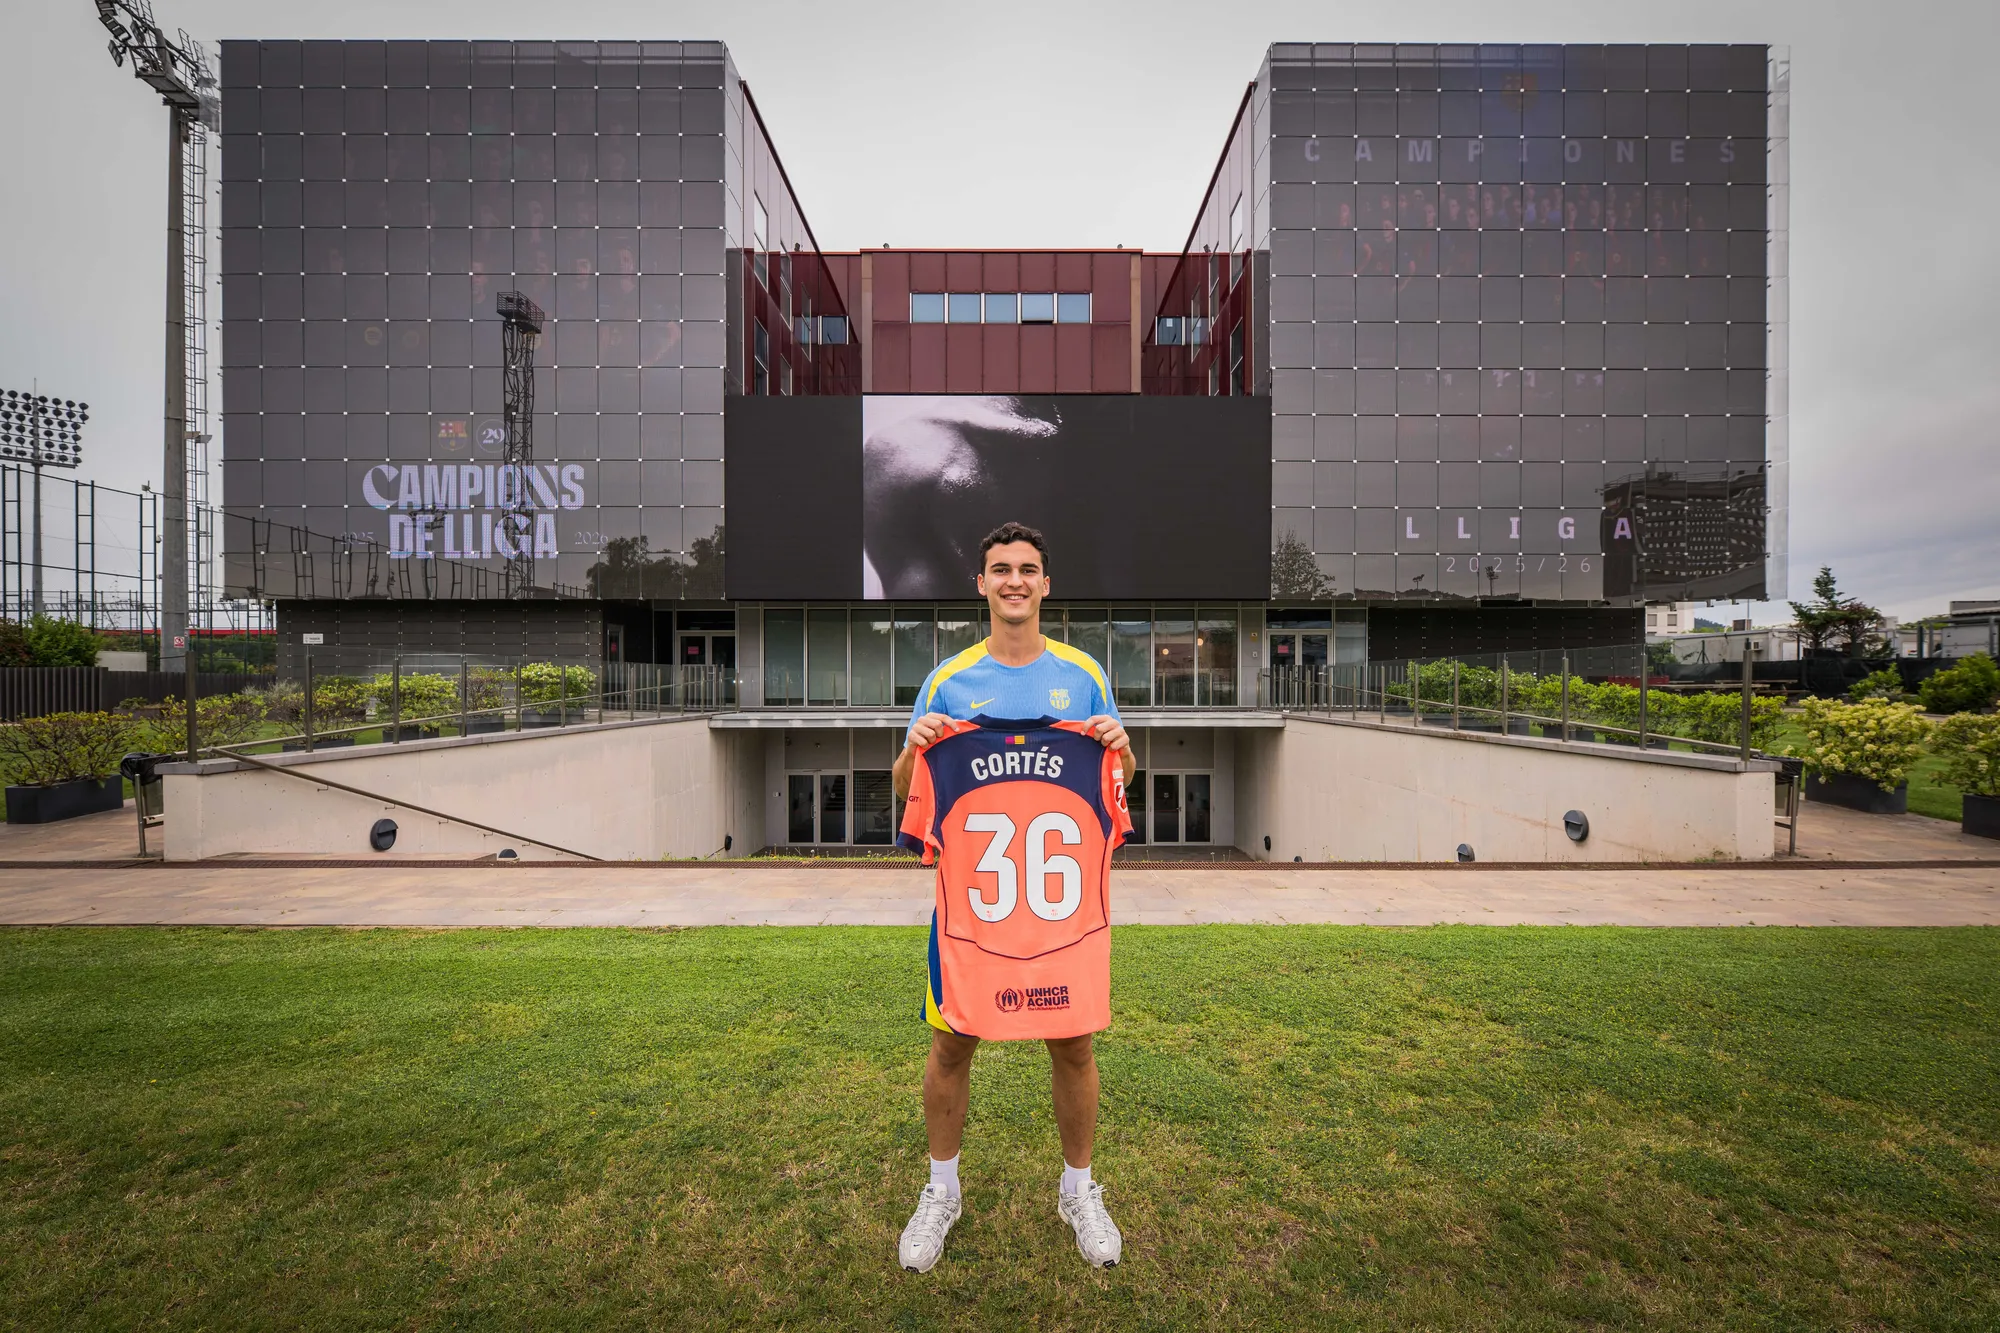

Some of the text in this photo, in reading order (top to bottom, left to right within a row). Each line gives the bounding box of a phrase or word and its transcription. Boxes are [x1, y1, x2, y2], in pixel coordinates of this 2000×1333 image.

[1304, 139, 1736, 163] CAMPIONES
[362, 464, 585, 510] CAMPIONS
[574, 531, 609, 545] 2026
[1405, 517, 1633, 540] LLIGA
[1446, 556, 1591, 573] 2025/26
[970, 746, 1064, 781] CORTÉS
[963, 811, 1082, 922] 36
[1026, 986, 1069, 997] UNHCR
[1027, 996, 1070, 1007] ACNUR
